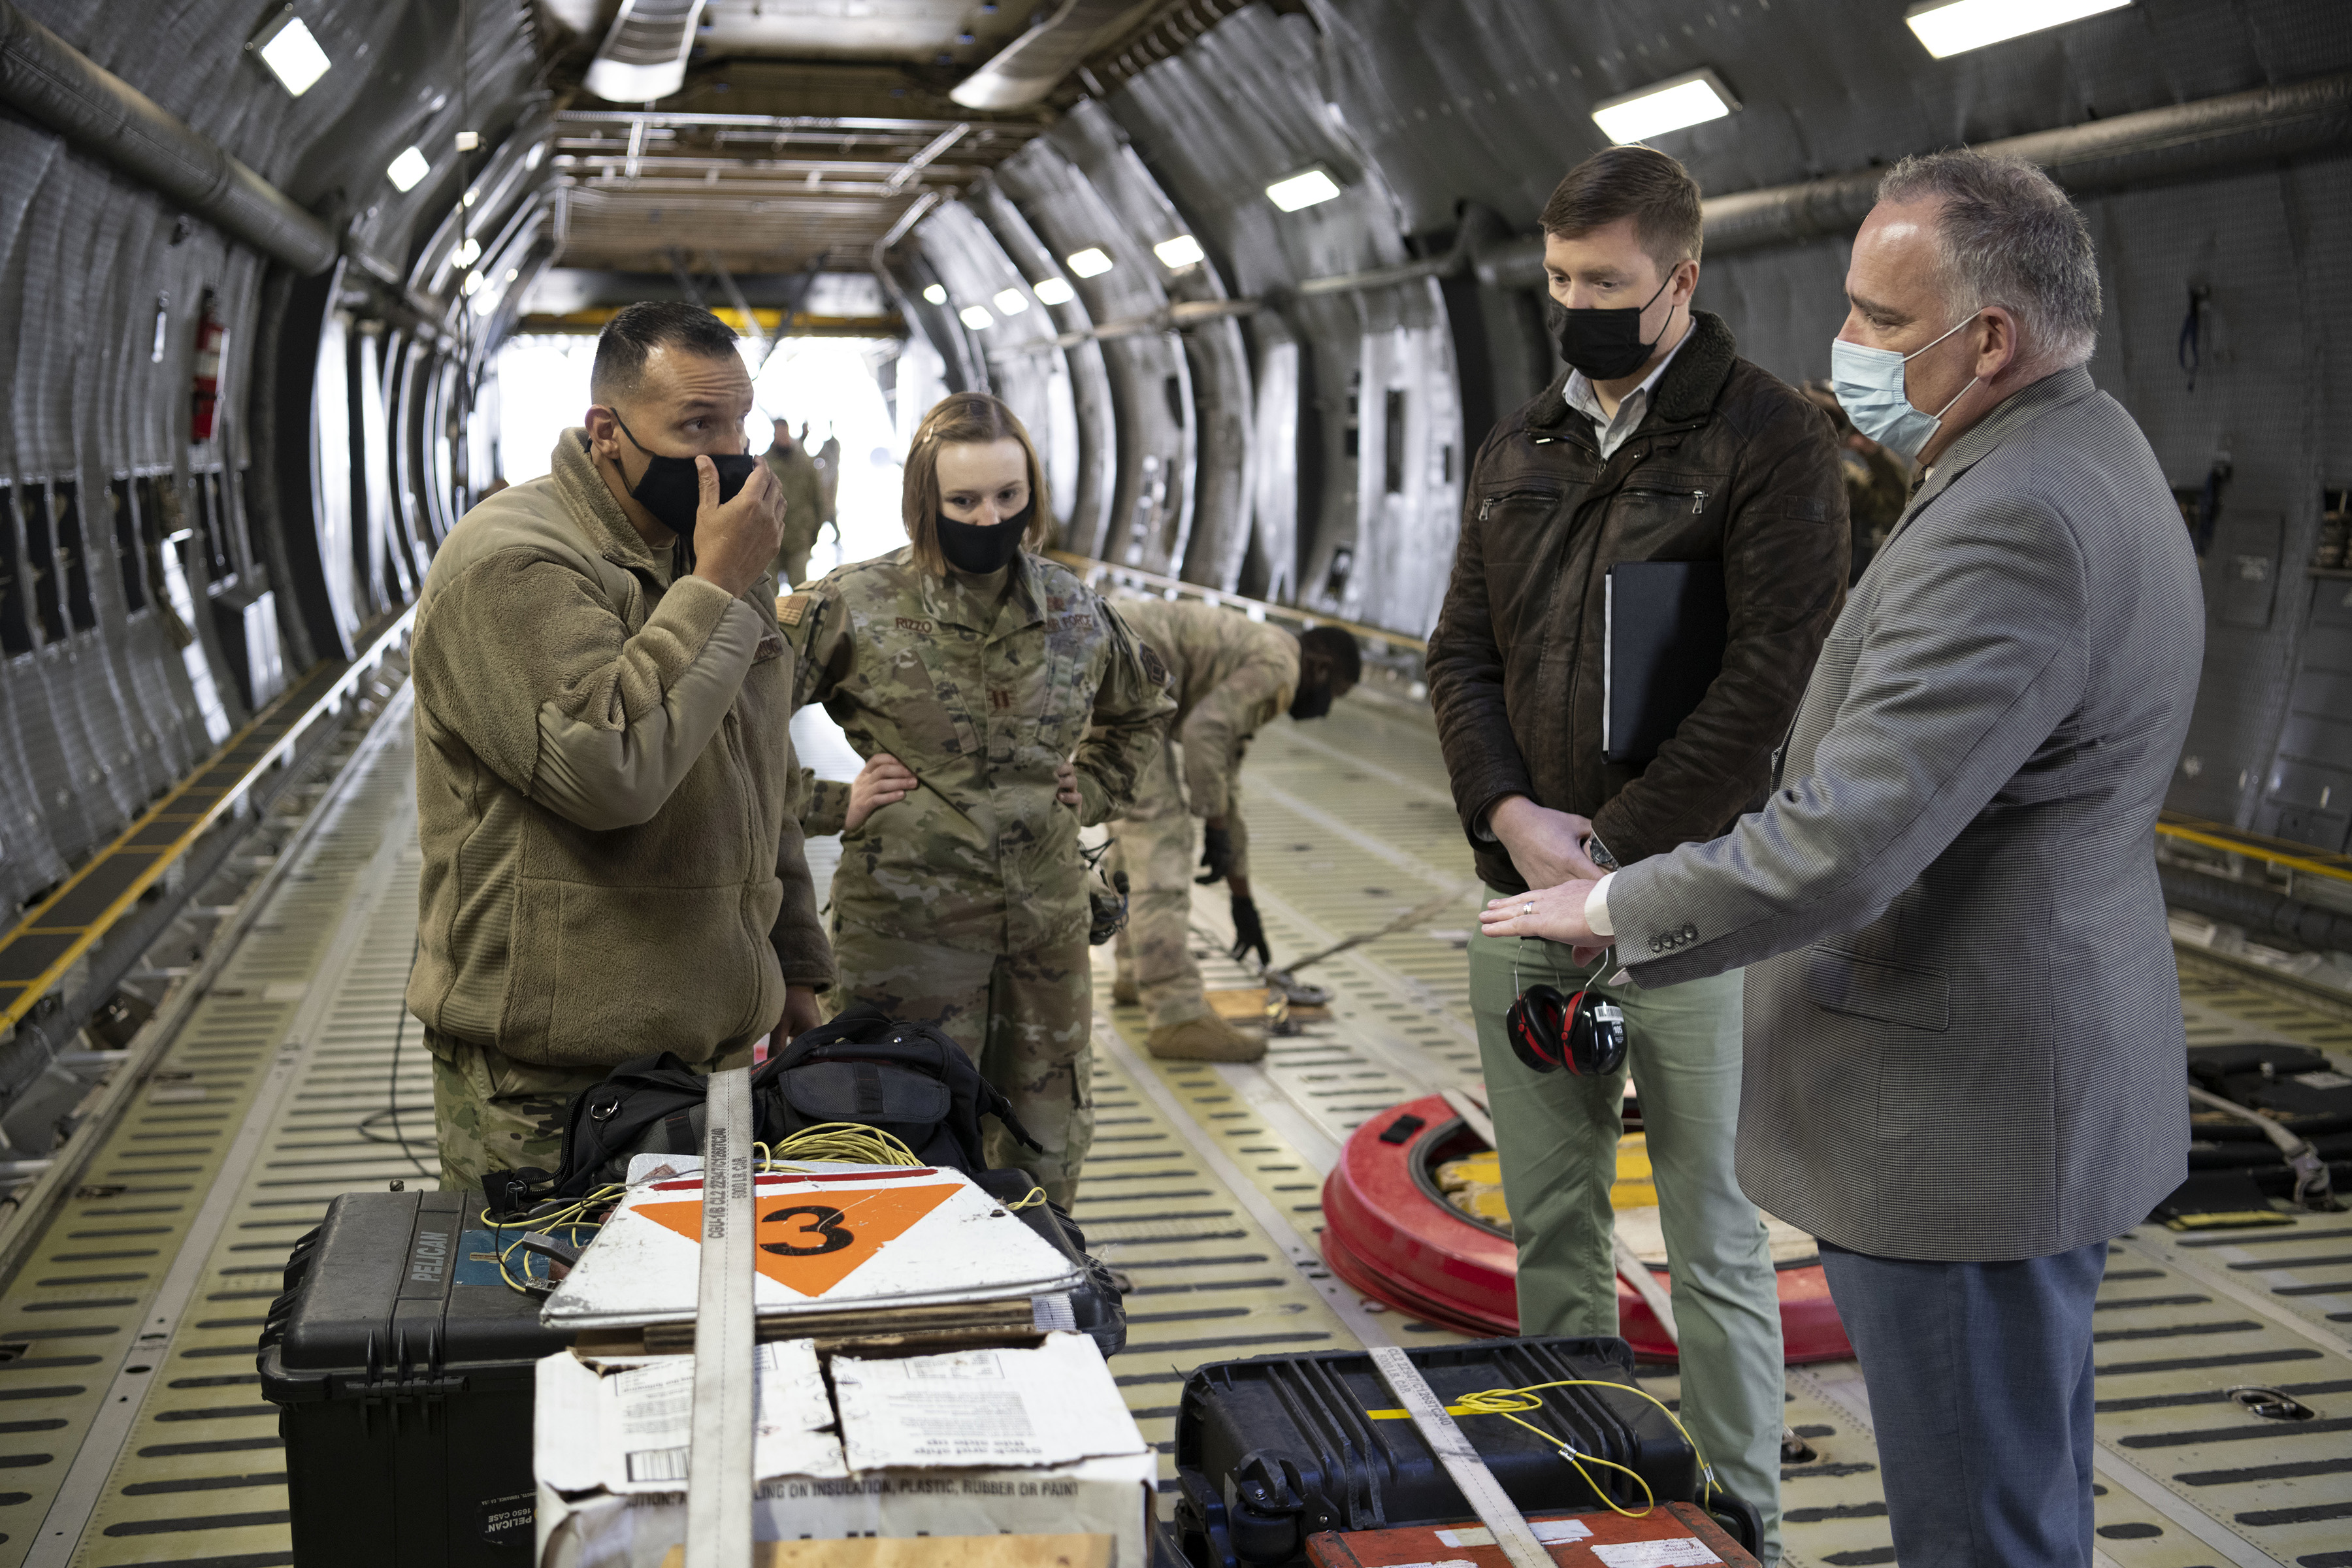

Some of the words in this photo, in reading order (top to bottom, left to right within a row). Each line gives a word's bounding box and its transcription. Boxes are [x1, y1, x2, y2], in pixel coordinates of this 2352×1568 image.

[895, 616, 932, 634] RIZZO
[1062, 613, 1093, 629] FORCE
[1613, 1025, 1623, 1034] 105
[710, 1190, 726, 1205] CL2
[731, 1183, 747, 1199] 5000
[708, 1206, 725, 1239] CGU-1/B
[759, 1205, 855, 1256] 3
[411, 1231, 448, 1282] PELICAN
[1375, 1354, 1395, 1370] 5000
[1388, 1348, 1404, 1362] CL2
[917, 1448, 951, 1456] ship
[789, 1482, 809, 1499] ON
[812, 1478, 896, 1497] INSULATION,
[900, 1478, 959, 1496] PLASTIC,
[963, 1480, 1015, 1497] RUBBER
[1019, 1480, 1038, 1497] OR
[497, 1494, 521, 1503] TORRANCE,
[488, 1512, 510, 1523] CASE
[512, 1508, 532, 1516] 1650
